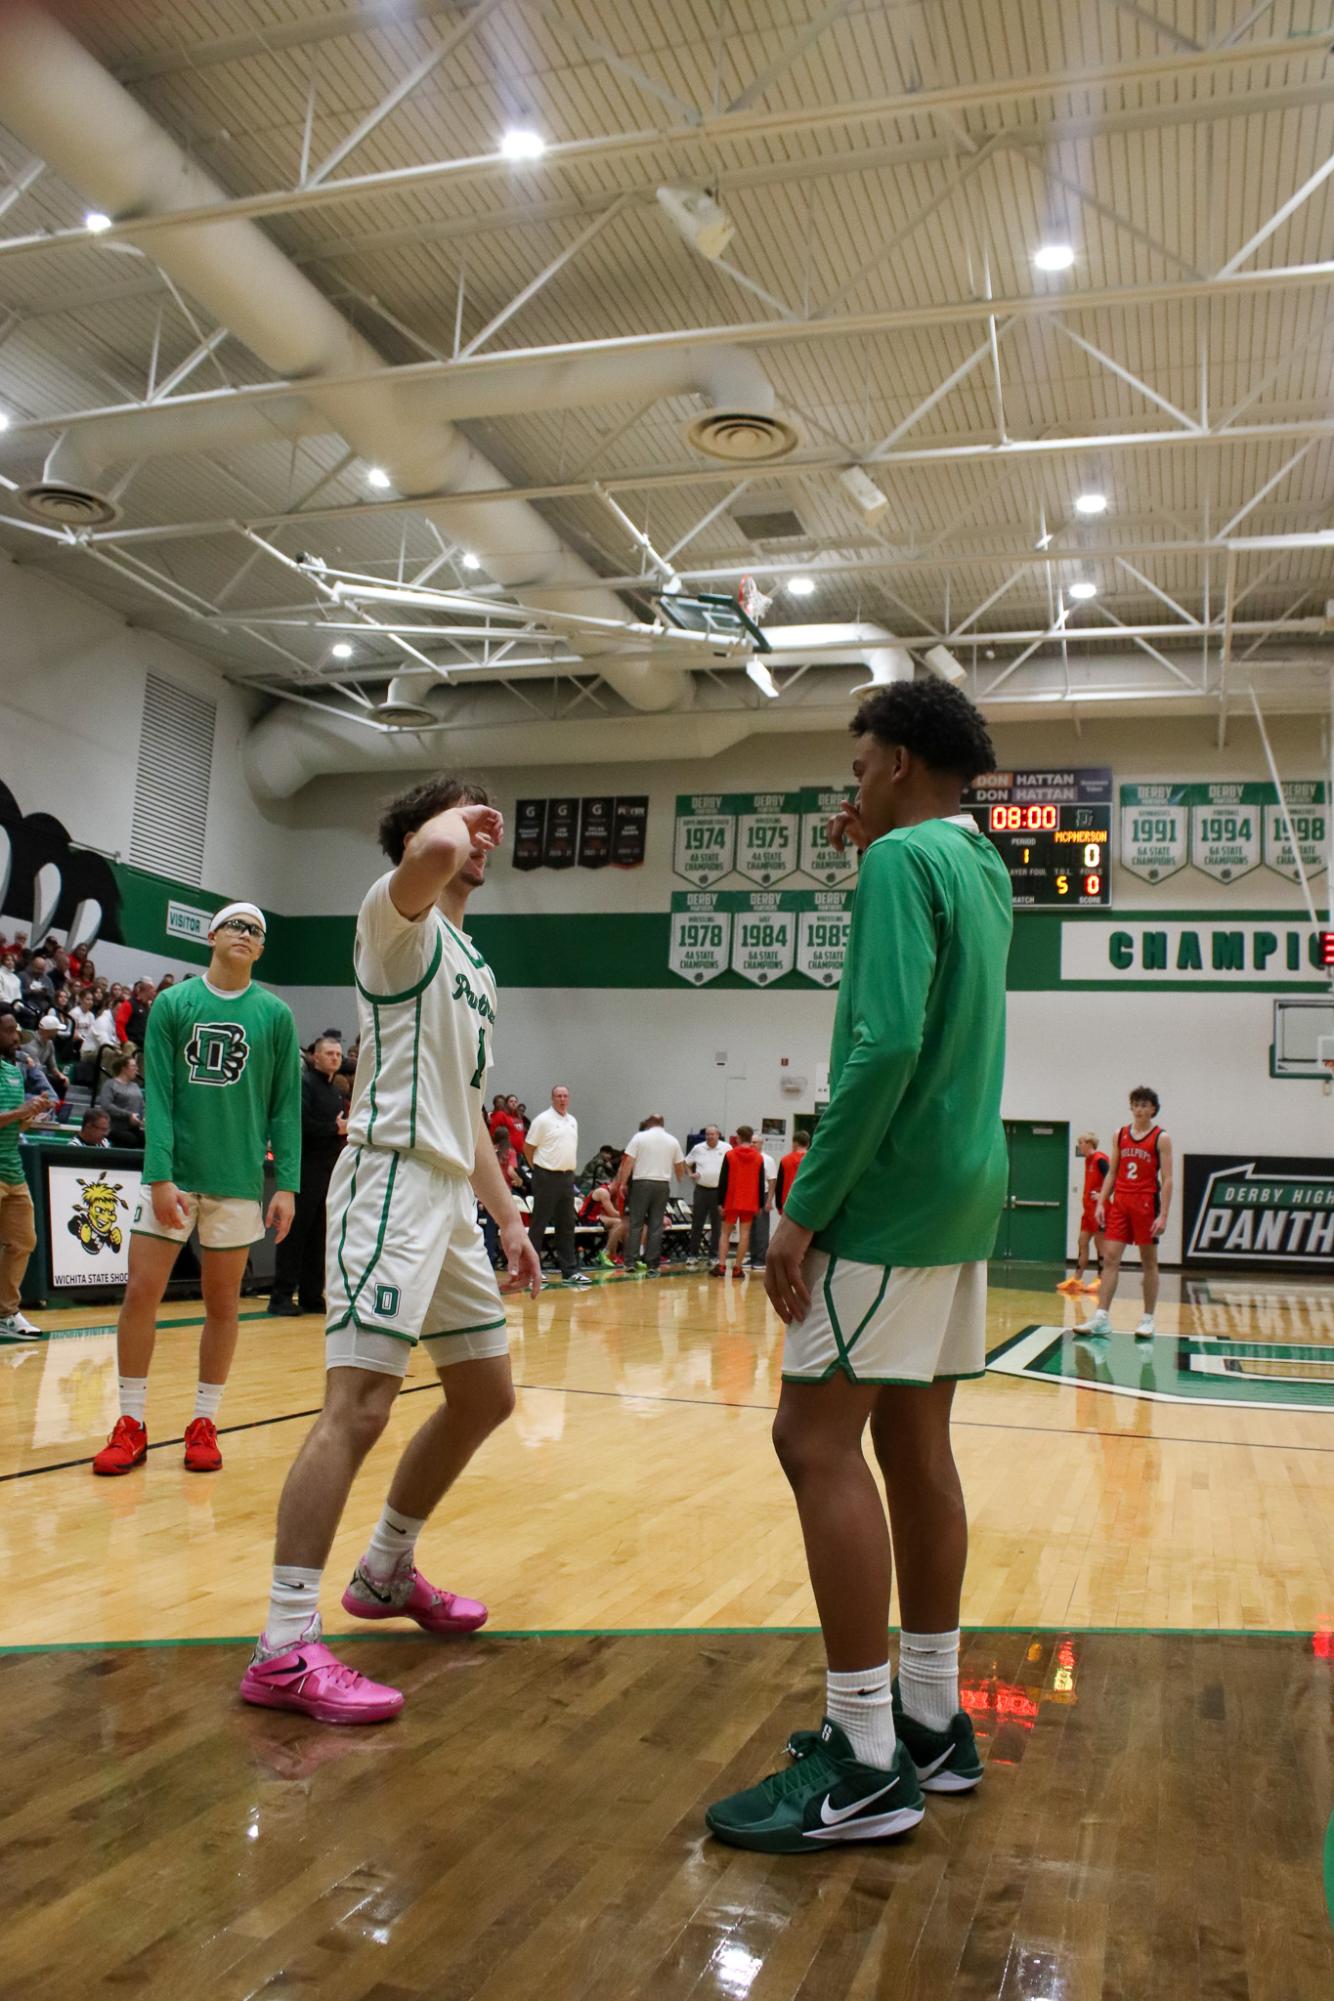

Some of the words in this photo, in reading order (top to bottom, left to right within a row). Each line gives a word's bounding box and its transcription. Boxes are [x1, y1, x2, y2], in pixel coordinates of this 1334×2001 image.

[976, 774, 1009, 787] DON
[1016, 773, 1075, 786] HATTAN
[976, 789, 1009, 801] DON
[1016, 788, 1075, 800] HATTAN
[1138, 785, 1172, 797] DERBY
[1209, 784, 1243, 797] DERBY
[1283, 784, 1317, 796] DERBY
[692, 797, 722, 808] DERBY
[754, 796, 784, 807] DERBY
[818, 794, 849, 806] DERBY
[526, 807, 536, 817] G
[557, 806, 568, 815] G
[591, 805, 603, 814] G
[992, 805, 1057, 830] 08:00
[1132, 819, 1177, 842] 1991
[1201, 818, 1252, 841] 1994
[684, 828, 726, 849] 1974
[746, 827, 789, 848] 1975
[1011, 838, 1037, 846] PERIOD
[1054, 831, 1108, 843] MCPHERSON
[1023, 848, 1030, 864] 1
[1084, 843, 1100, 868] 0
[1149, 846, 1169, 856] STATE
[1221, 846, 1241, 855] STATE
[1294, 846, 1315, 854] TATE
[700, 853, 719, 861] STATE
[762, 852, 781, 861] STATE
[1131, 856, 1175, 866] CHAMPIONS
[1203, 855, 1248, 865] CHAMPIONS
[684, 862, 723, 872] CHAMPIONS
[746, 861, 785, 871] CHAMPIONS
[810, 861, 851, 870] CHAMPIONS
[1056, 875, 1068, 895] 5
[1086, 874, 1100, 895] 0
[687, 893, 719, 905] DERBY
[751, 893, 782, 905] DERBY
[815, 892, 846, 904] DERBY
[170, 911, 200, 933] VISITOR
[679, 925, 722, 947] 1978
[741, 925, 788, 947] 1984
[695, 951, 714, 960] STATE
[759, 951, 778, 960] STATE
[680, 961, 718, 970] CHAMPIONS
[743, 961, 783, 970] CHAMPIONS
[1127, 1162, 1138, 1179] 2
[1224, 1187, 1283, 1203] DERBY
[1292, 1189, 1334, 1204] HIGH
[1198, 1208, 1334, 1253] PANTH
[55, 1274, 86, 1285] WICHITA
[88, 1273, 109, 1283] STATE
[372, 1283, 402, 1318] D
